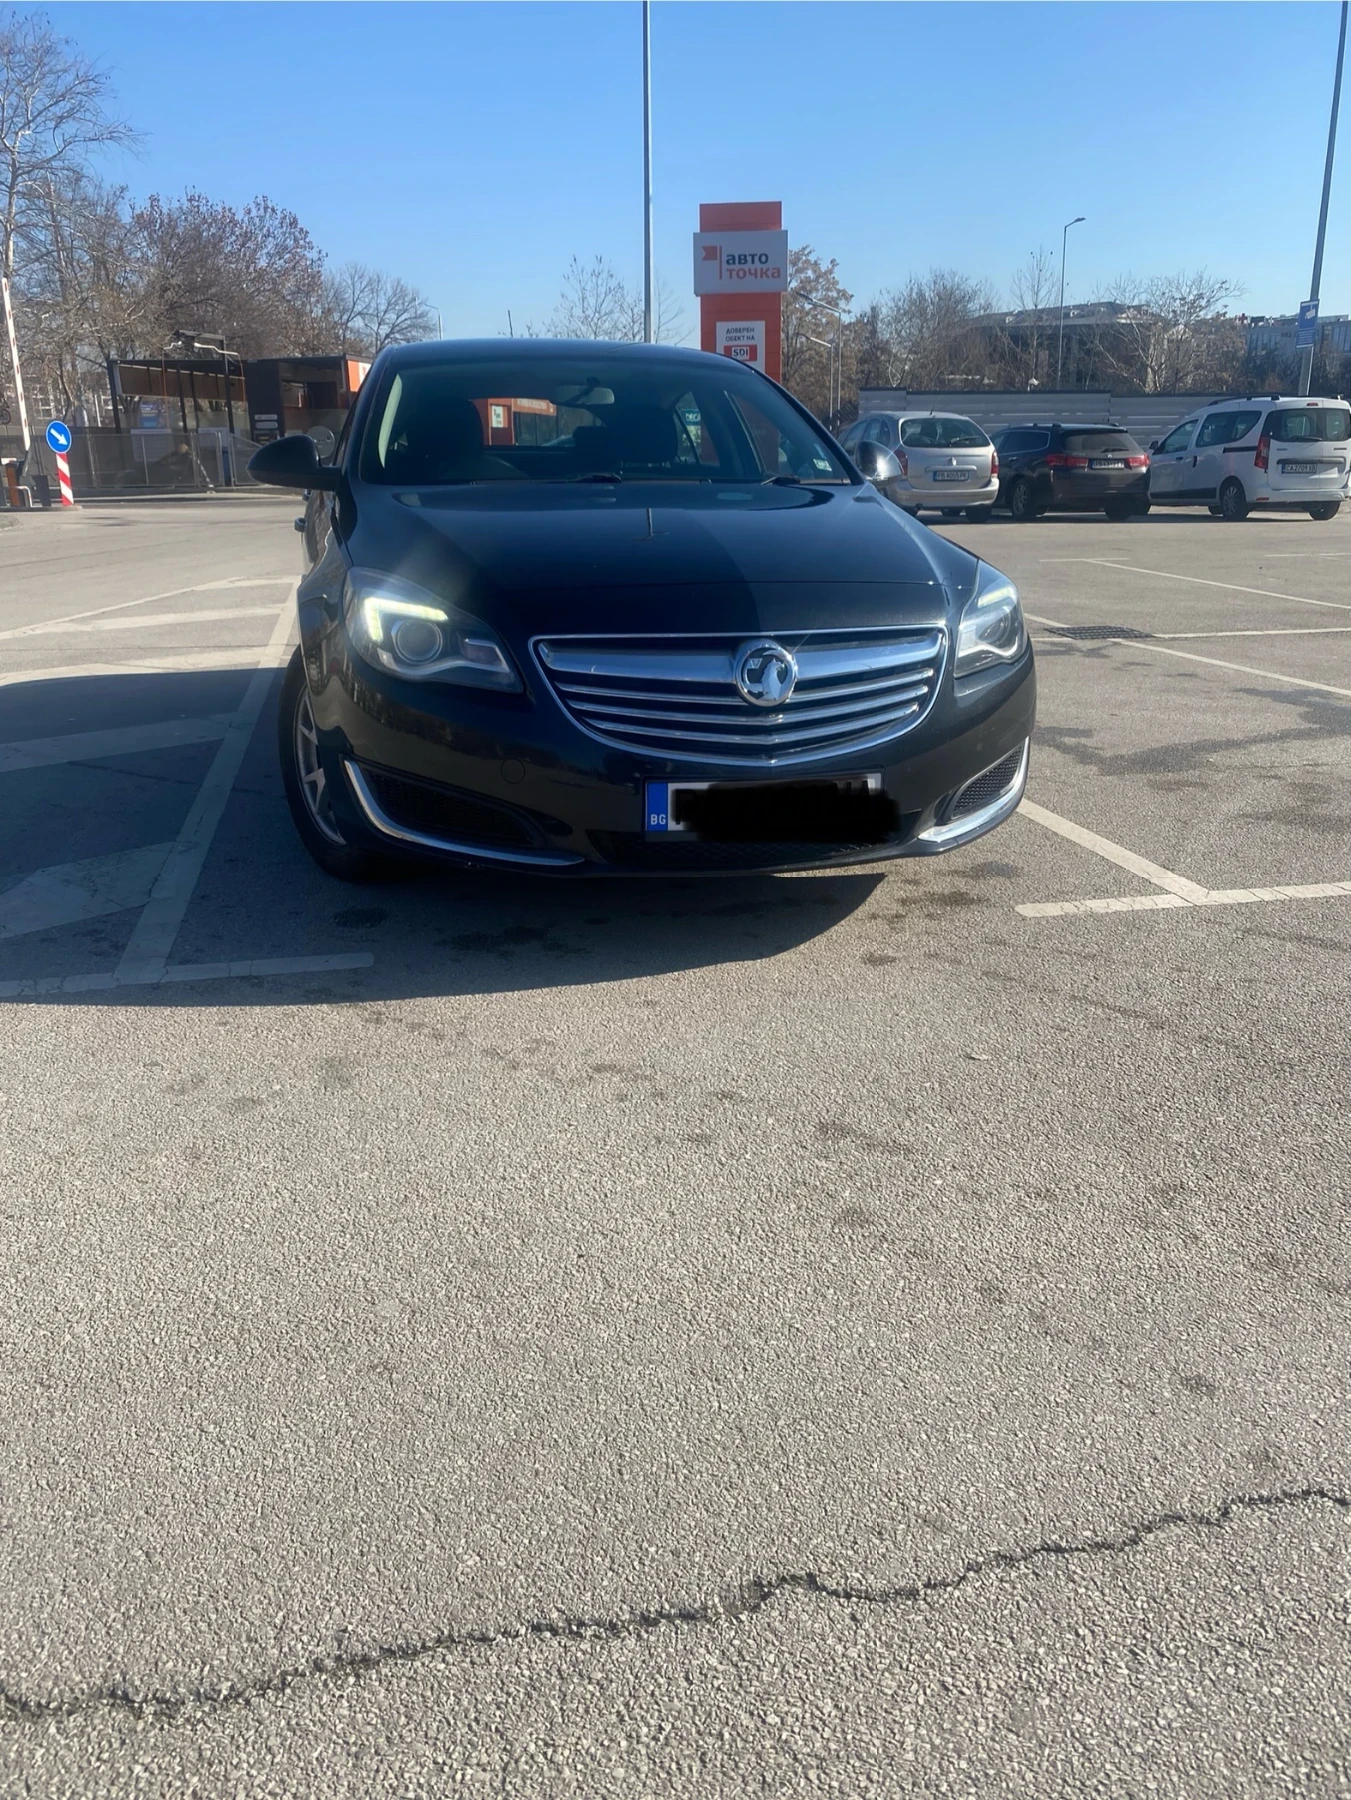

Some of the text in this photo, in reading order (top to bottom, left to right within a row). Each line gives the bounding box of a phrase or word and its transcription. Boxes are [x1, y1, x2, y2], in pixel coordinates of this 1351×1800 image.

[726, 253, 769, 265] авто
[727, 267, 781, 279] точка
[733, 348, 748, 357] SDI
[651, 814, 666, 825] BG
